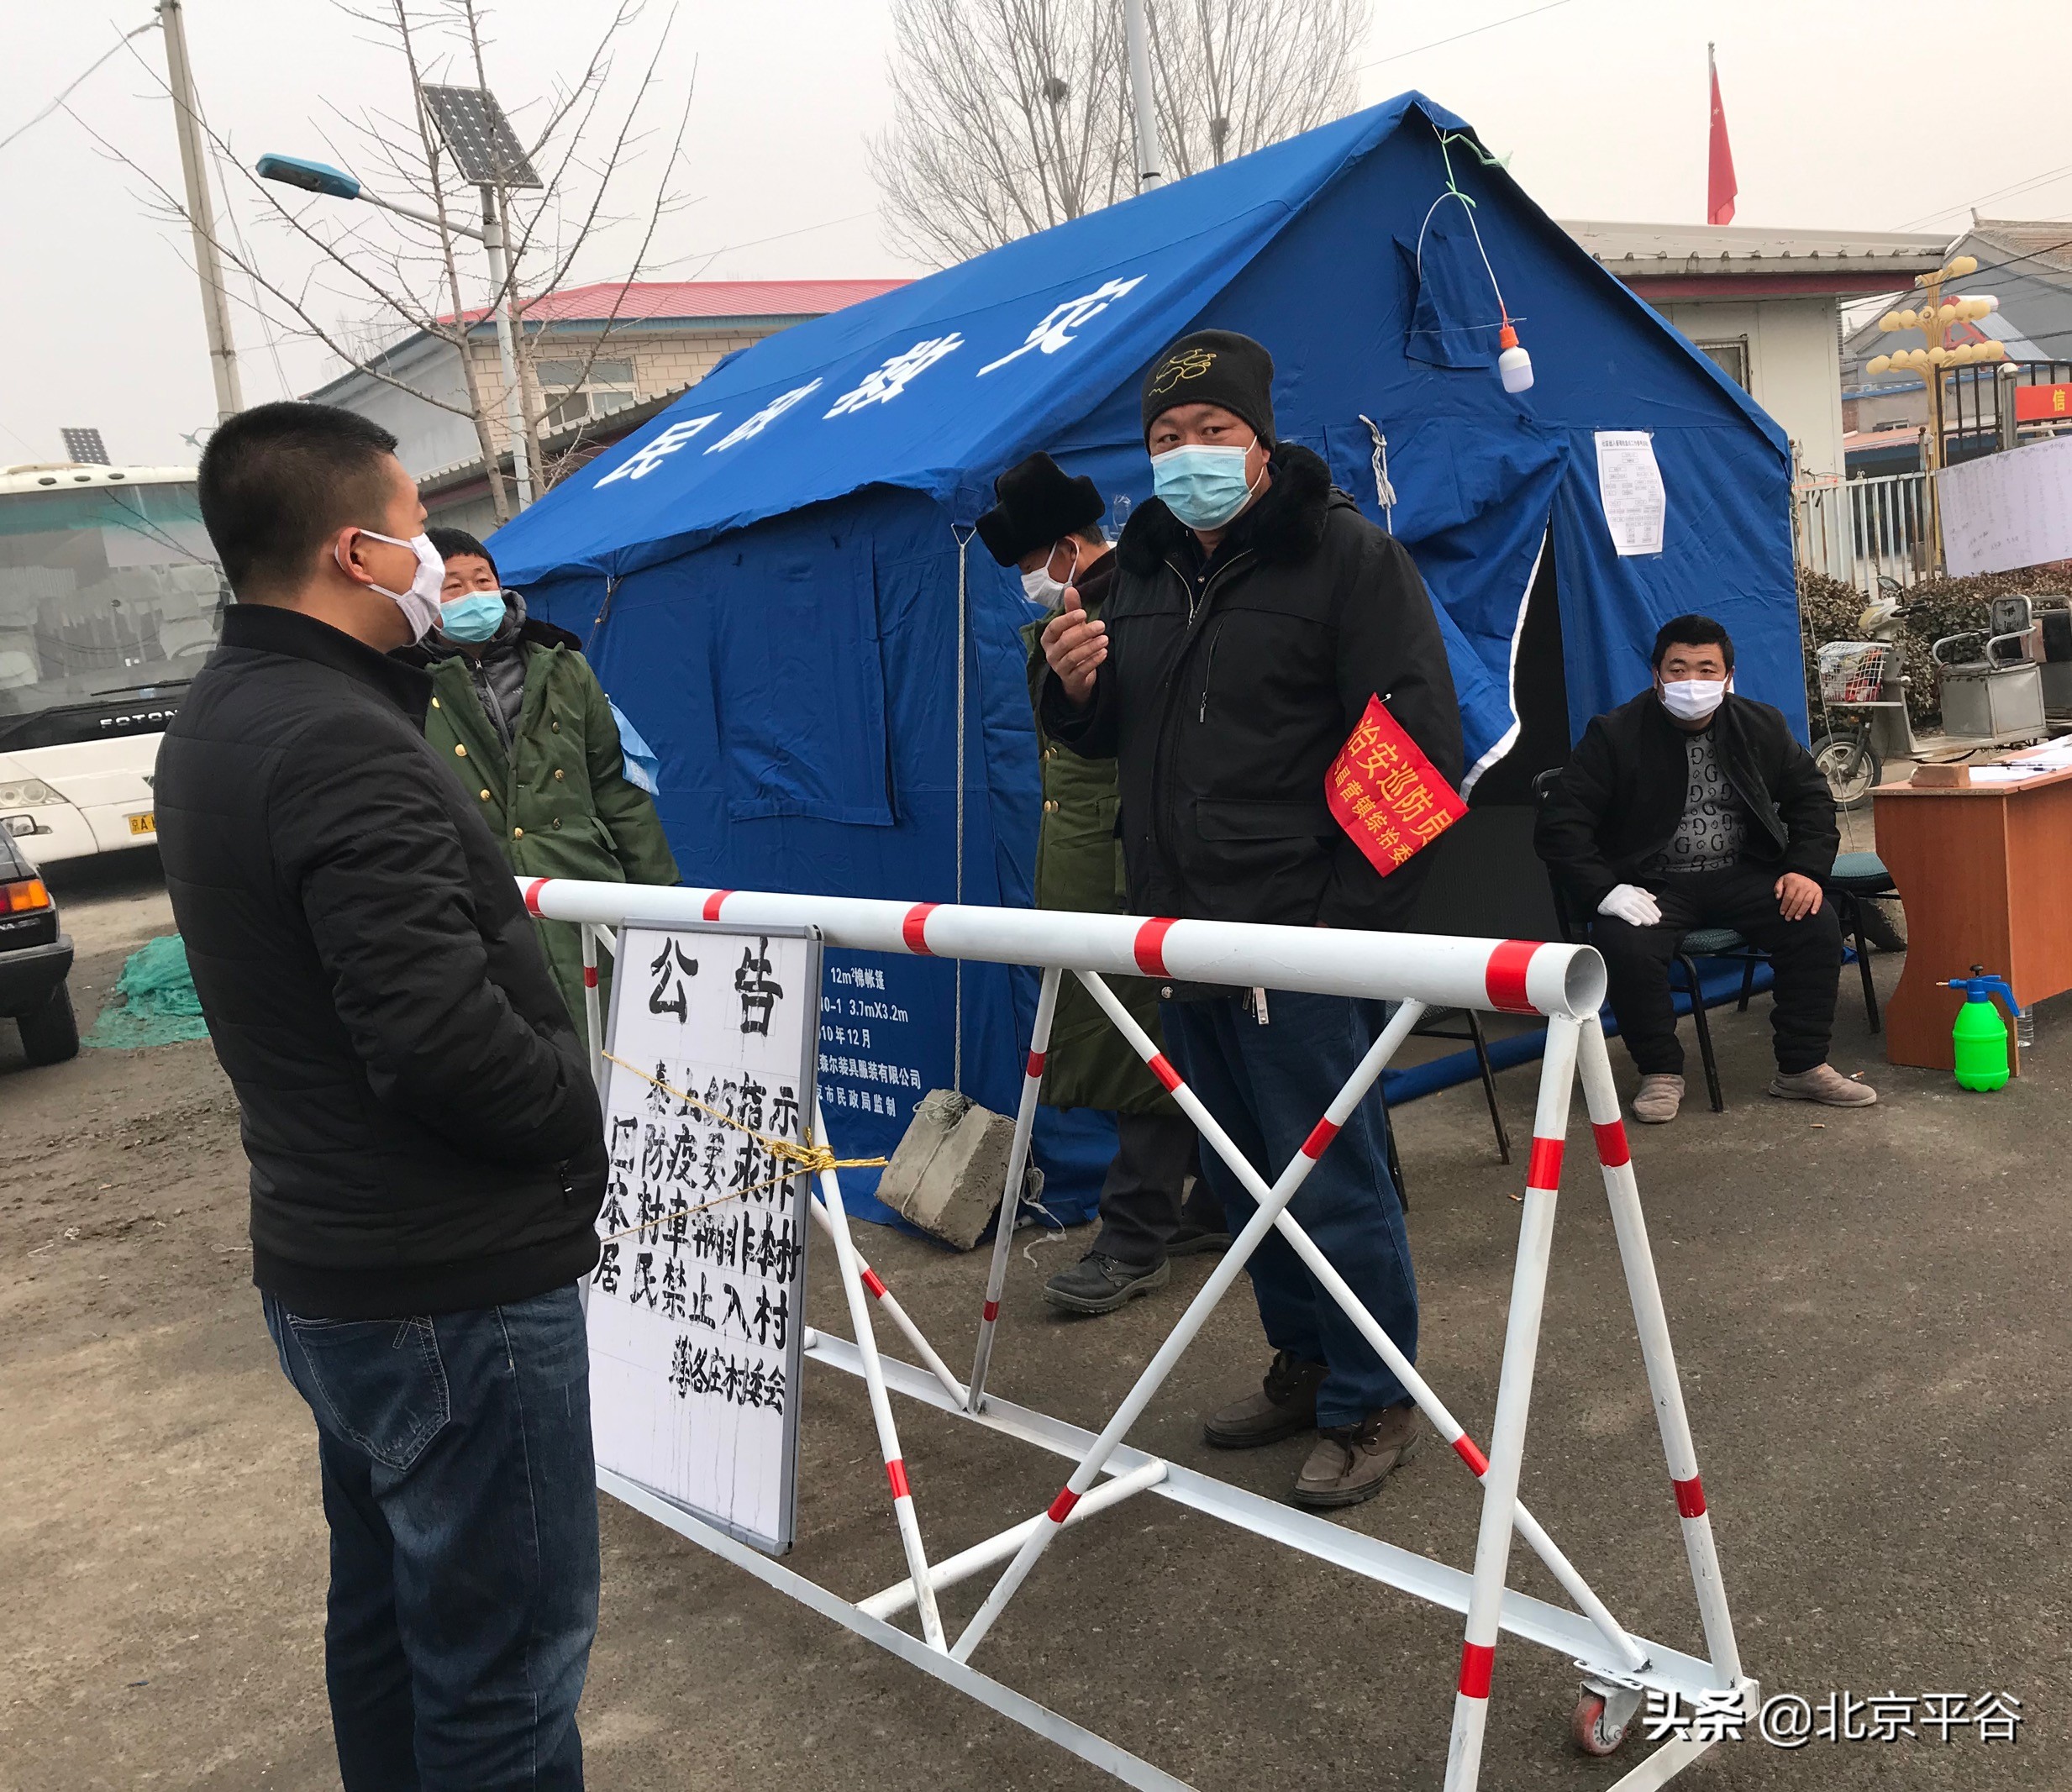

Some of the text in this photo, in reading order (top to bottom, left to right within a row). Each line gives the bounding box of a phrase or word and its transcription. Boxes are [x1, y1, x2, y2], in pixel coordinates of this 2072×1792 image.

[593, 274, 1148, 489] 民政救灾
[2052, 389, 2066, 412] 信
[1347, 716, 1454, 847] 治安巡防员
[649, 936, 783, 1038] 公告
[817, 1053, 923, 1090] 森尔装具服装有限公司
[591, 1242, 789, 1350] 居民禁止入村
